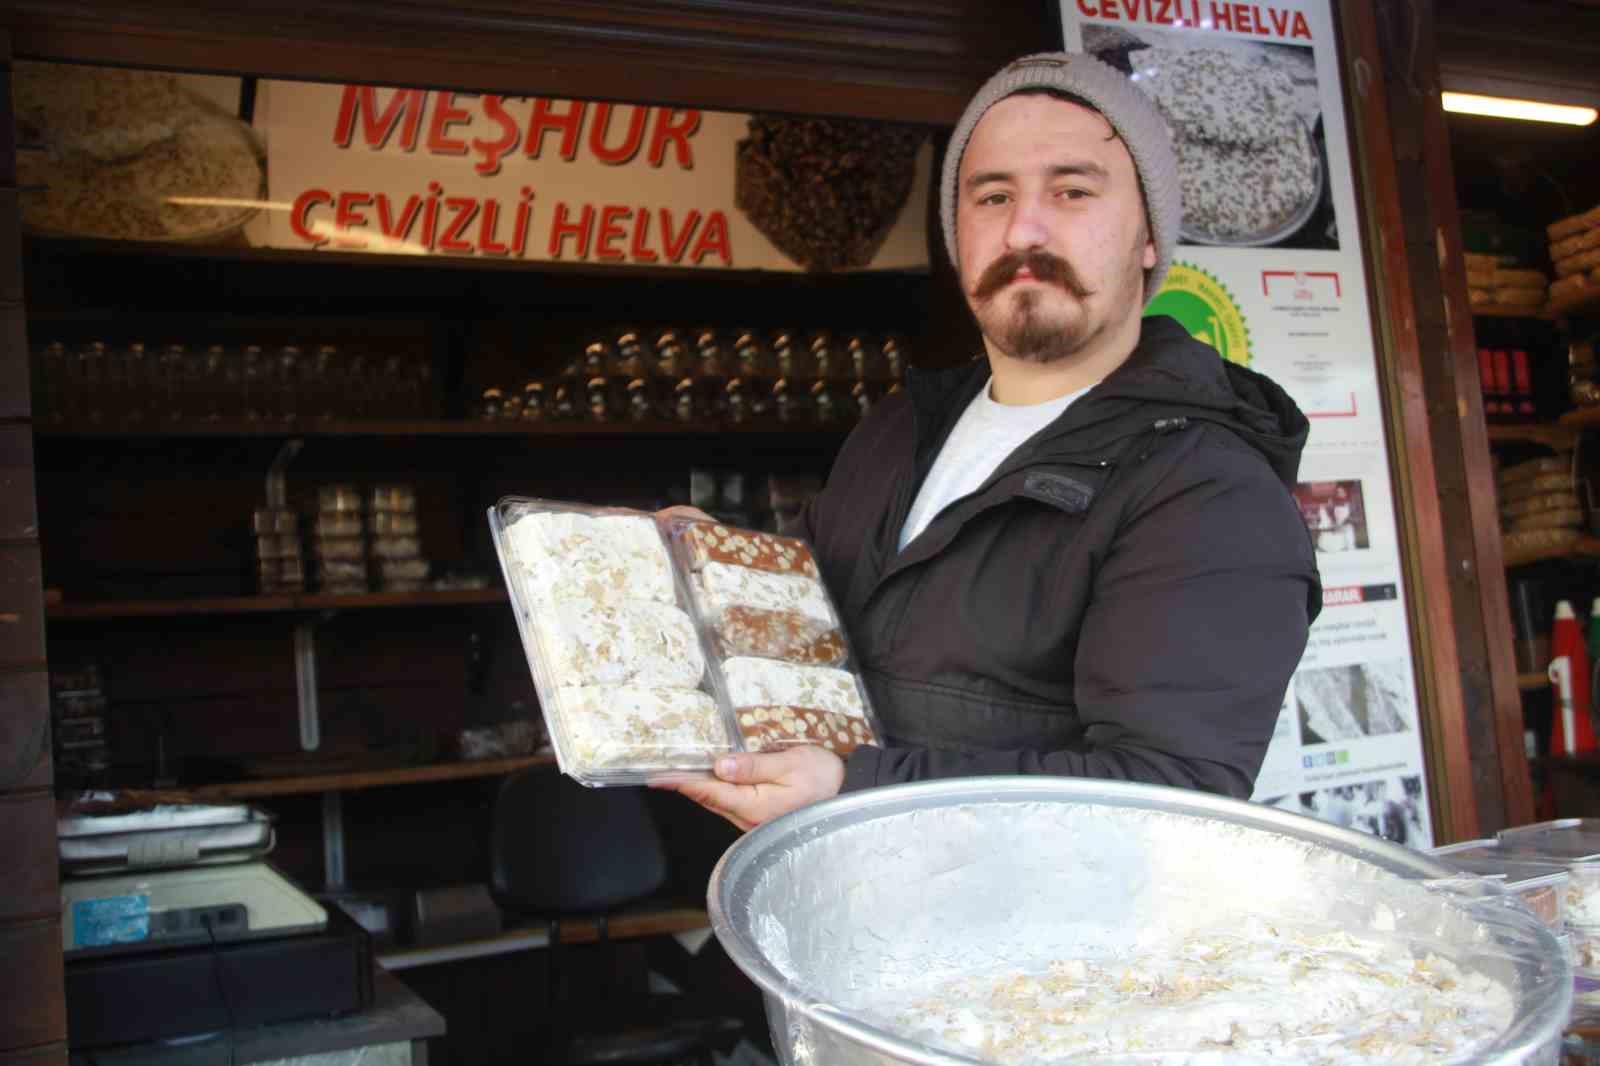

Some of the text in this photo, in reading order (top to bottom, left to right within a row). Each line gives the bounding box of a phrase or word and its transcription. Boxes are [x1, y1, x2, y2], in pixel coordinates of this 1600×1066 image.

[1210, 1, 1312, 40] HELVA
[332, 84, 702, 176] MEŞHUR
[547, 202, 733, 269] HELVA
